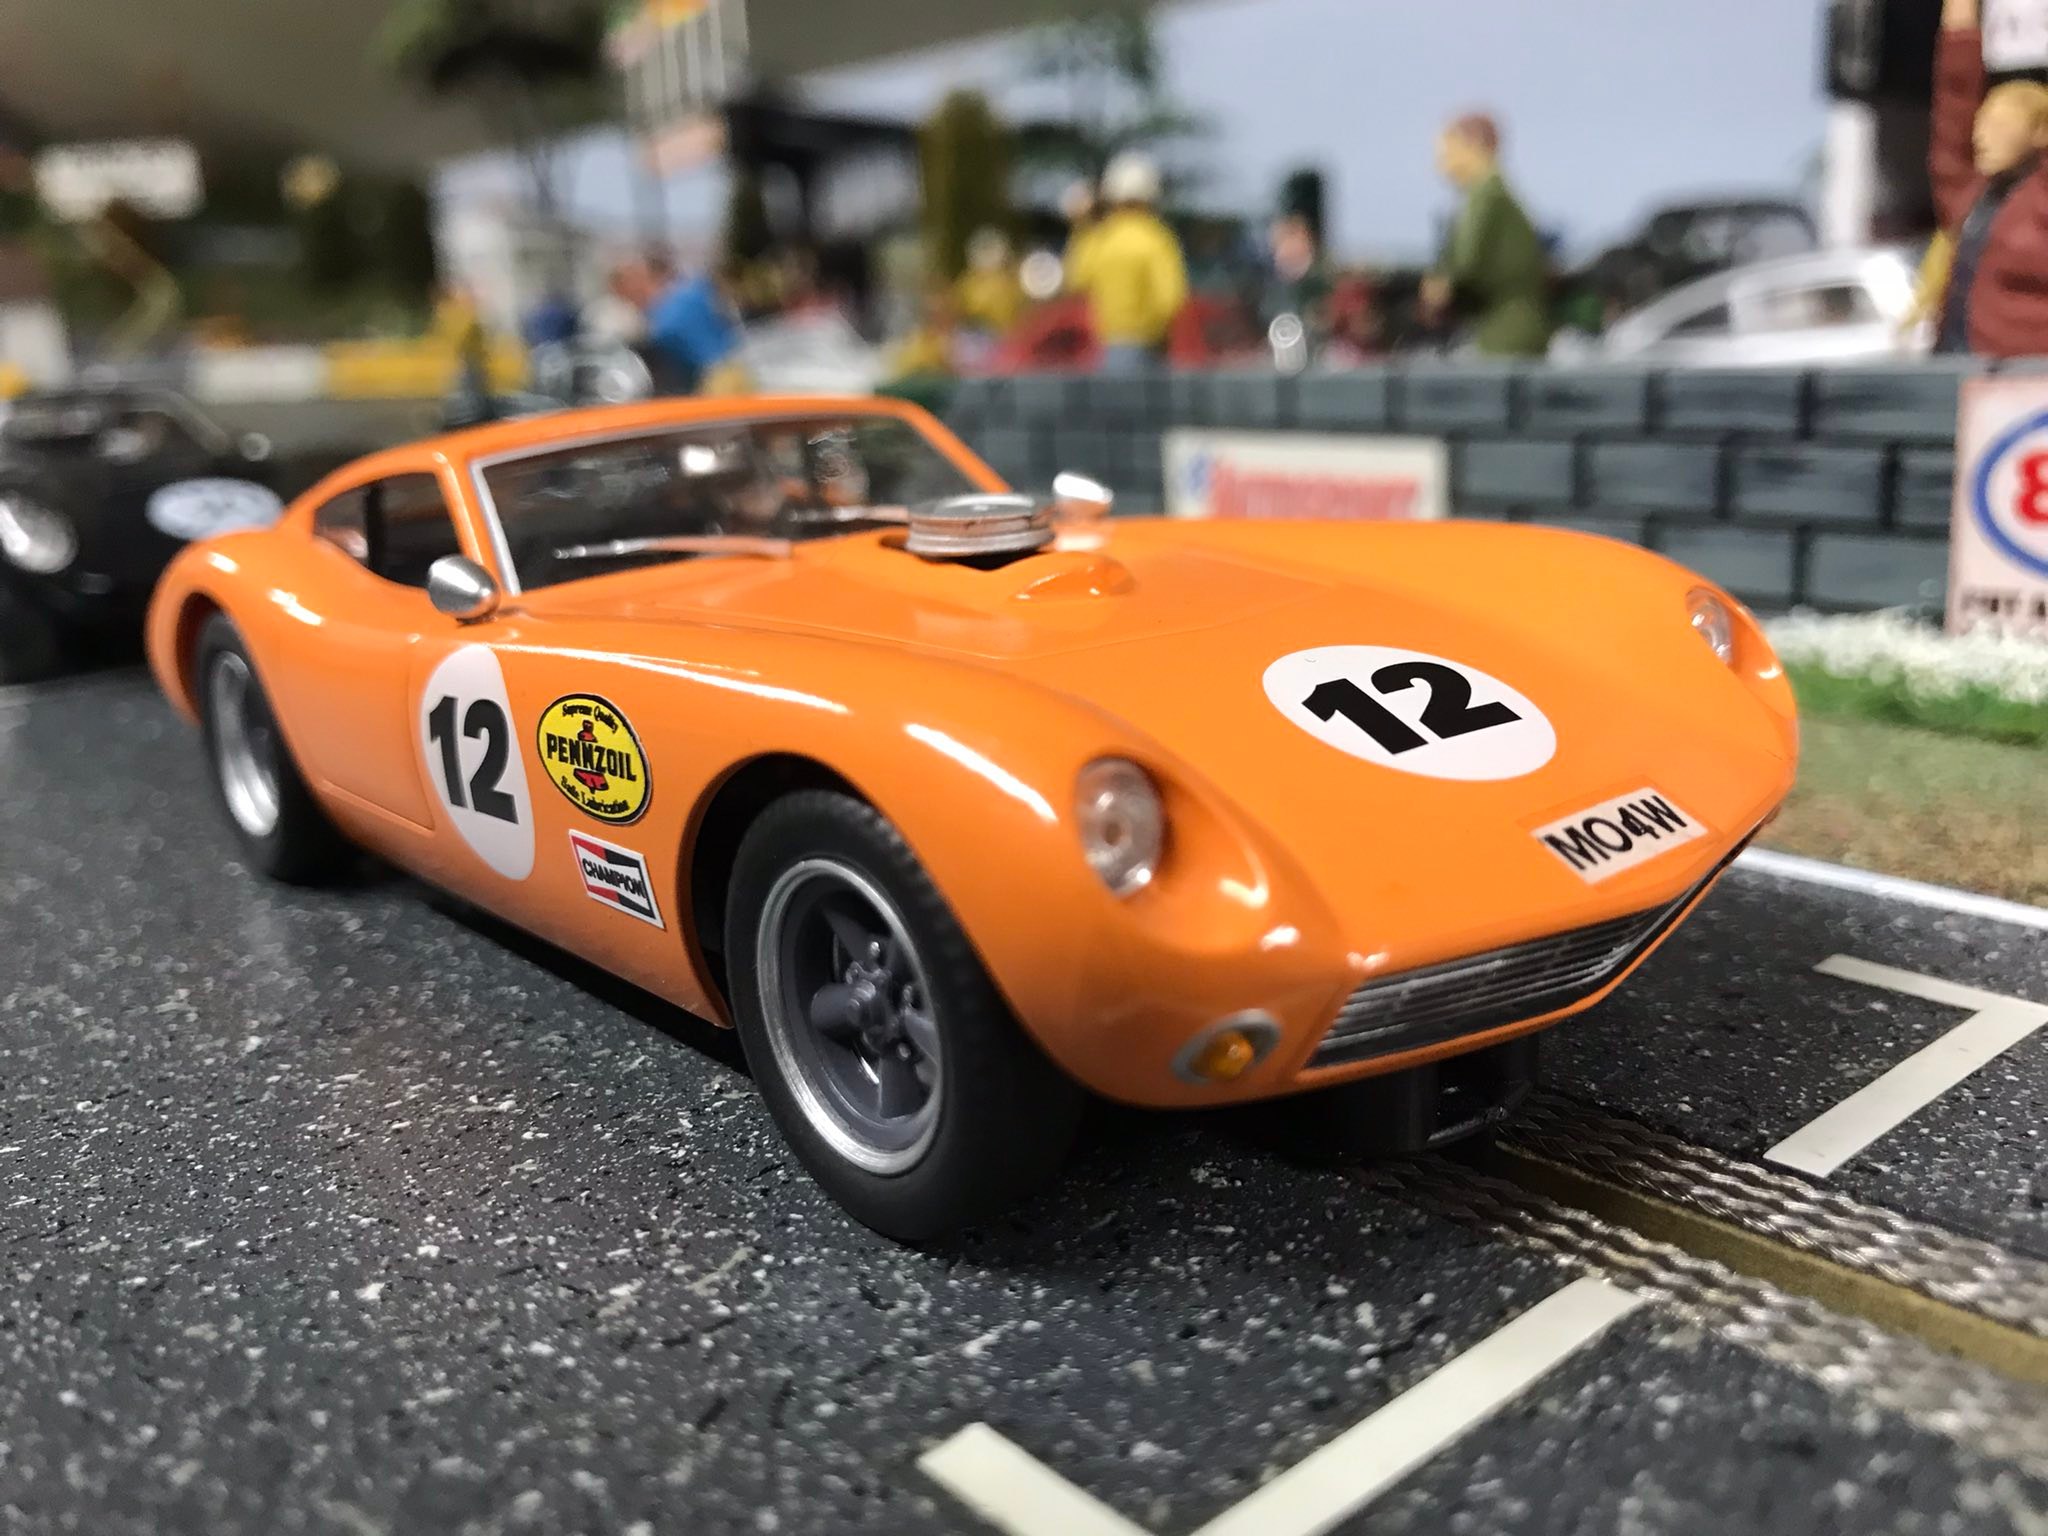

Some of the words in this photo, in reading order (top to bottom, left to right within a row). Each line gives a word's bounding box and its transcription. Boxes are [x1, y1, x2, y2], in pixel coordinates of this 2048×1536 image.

[1301, 660, 1523, 756] 12
[429, 695, 519, 825] 12
[546, 733, 637, 783] PENNZOIL
[582, 857, 647, 899] CHAMPION
